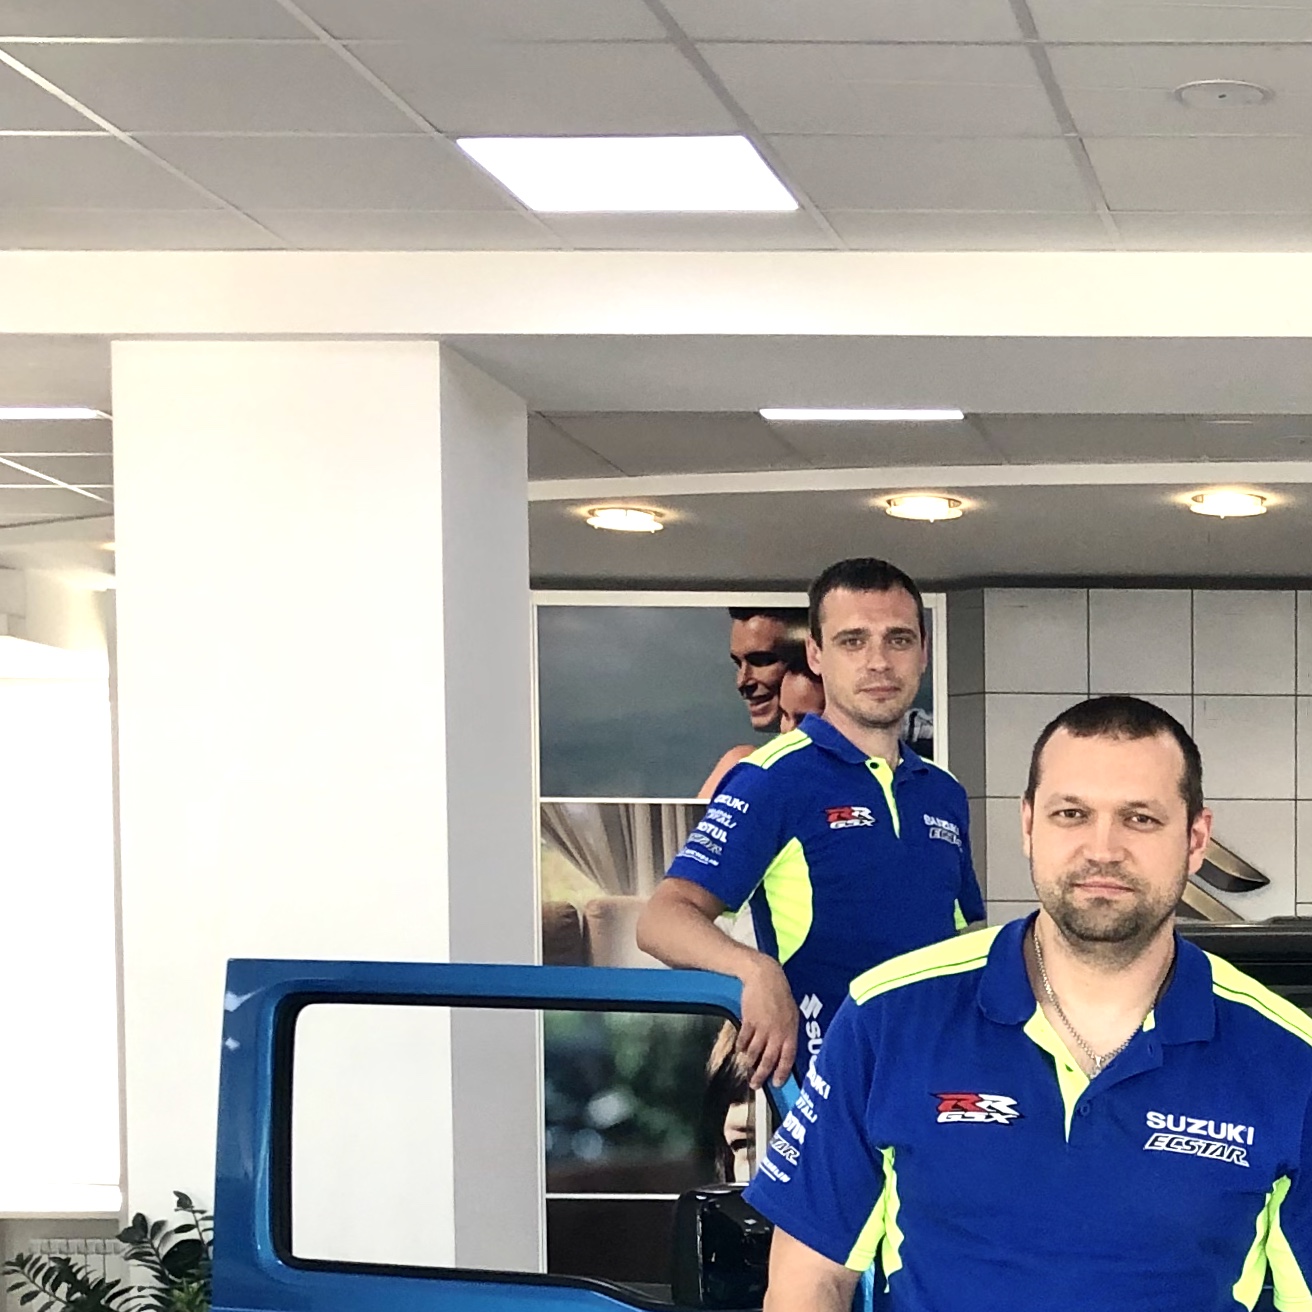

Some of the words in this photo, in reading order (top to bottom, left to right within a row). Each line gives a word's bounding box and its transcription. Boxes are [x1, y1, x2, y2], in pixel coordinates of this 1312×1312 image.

[935, 1093, 1020, 1115] RR
[936, 1111, 1018, 1124] GSX
[1146, 1110, 1255, 1146] SUZUKI
[1143, 1132, 1250, 1168] ECSTAR
